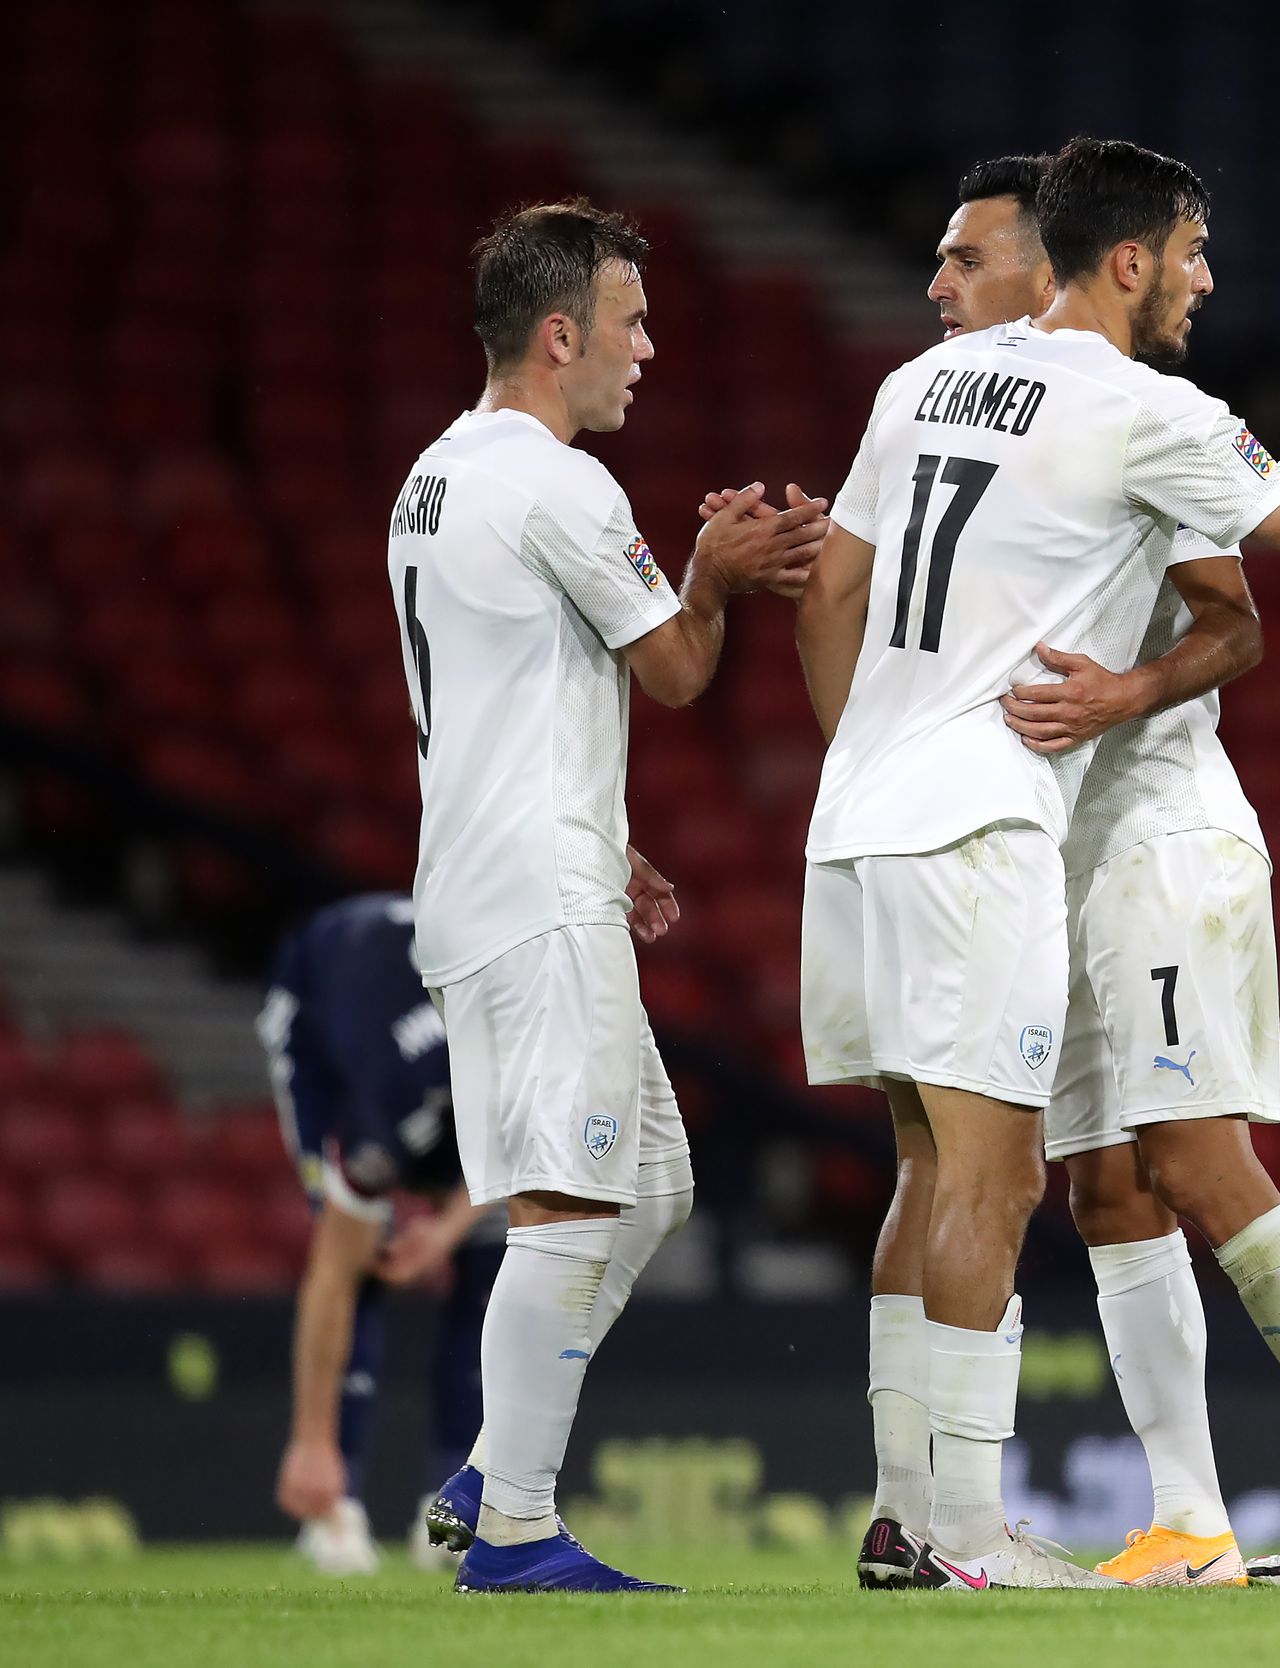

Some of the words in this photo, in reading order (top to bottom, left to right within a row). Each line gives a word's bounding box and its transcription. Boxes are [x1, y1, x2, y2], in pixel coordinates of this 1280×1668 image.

[914, 369, 1047, 437] ELHAMED
[889, 453, 1000, 653] 17
[1028, 1028, 1048, 1038] ISRAEL
[1150, 965, 1179, 1047] 7
[591, 1118, 612, 1128] ISRAEL
